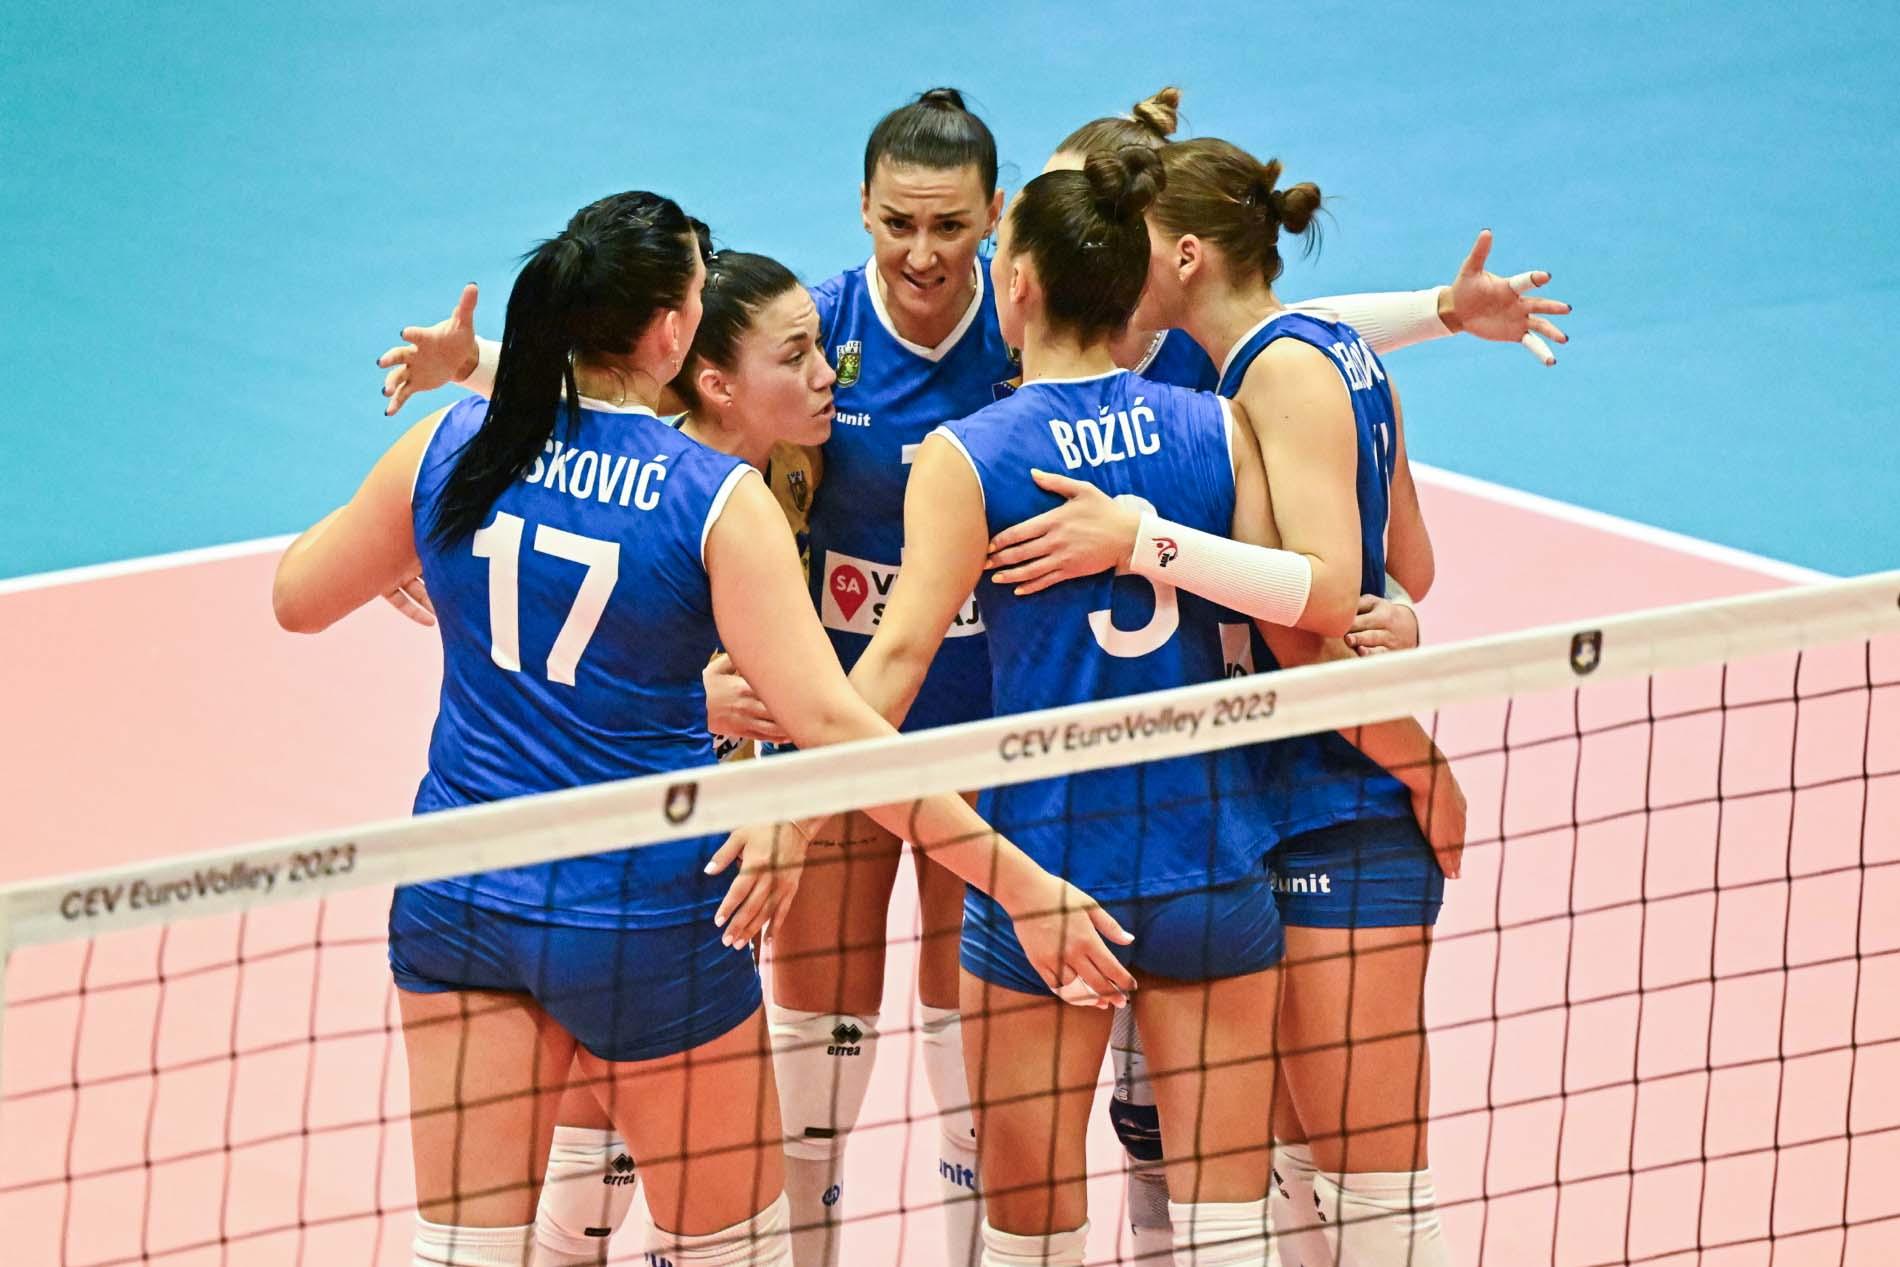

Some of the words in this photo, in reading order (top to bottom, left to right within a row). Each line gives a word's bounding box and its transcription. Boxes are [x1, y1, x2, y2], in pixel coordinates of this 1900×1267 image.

[1048, 397, 1161, 470] BOŽIĆ
[472, 510, 621, 687] 17
[836, 575, 862, 595] SA
[998, 727, 1058, 761] CEV
[1062, 706, 1204, 751] EuroVolley
[1212, 690, 1278, 727] 2023
[60, 887, 126, 921] CEV
[129, 860, 281, 910] EuroVolley
[288, 843, 358, 882] 2023
[827, 1045, 861, 1057] errea
